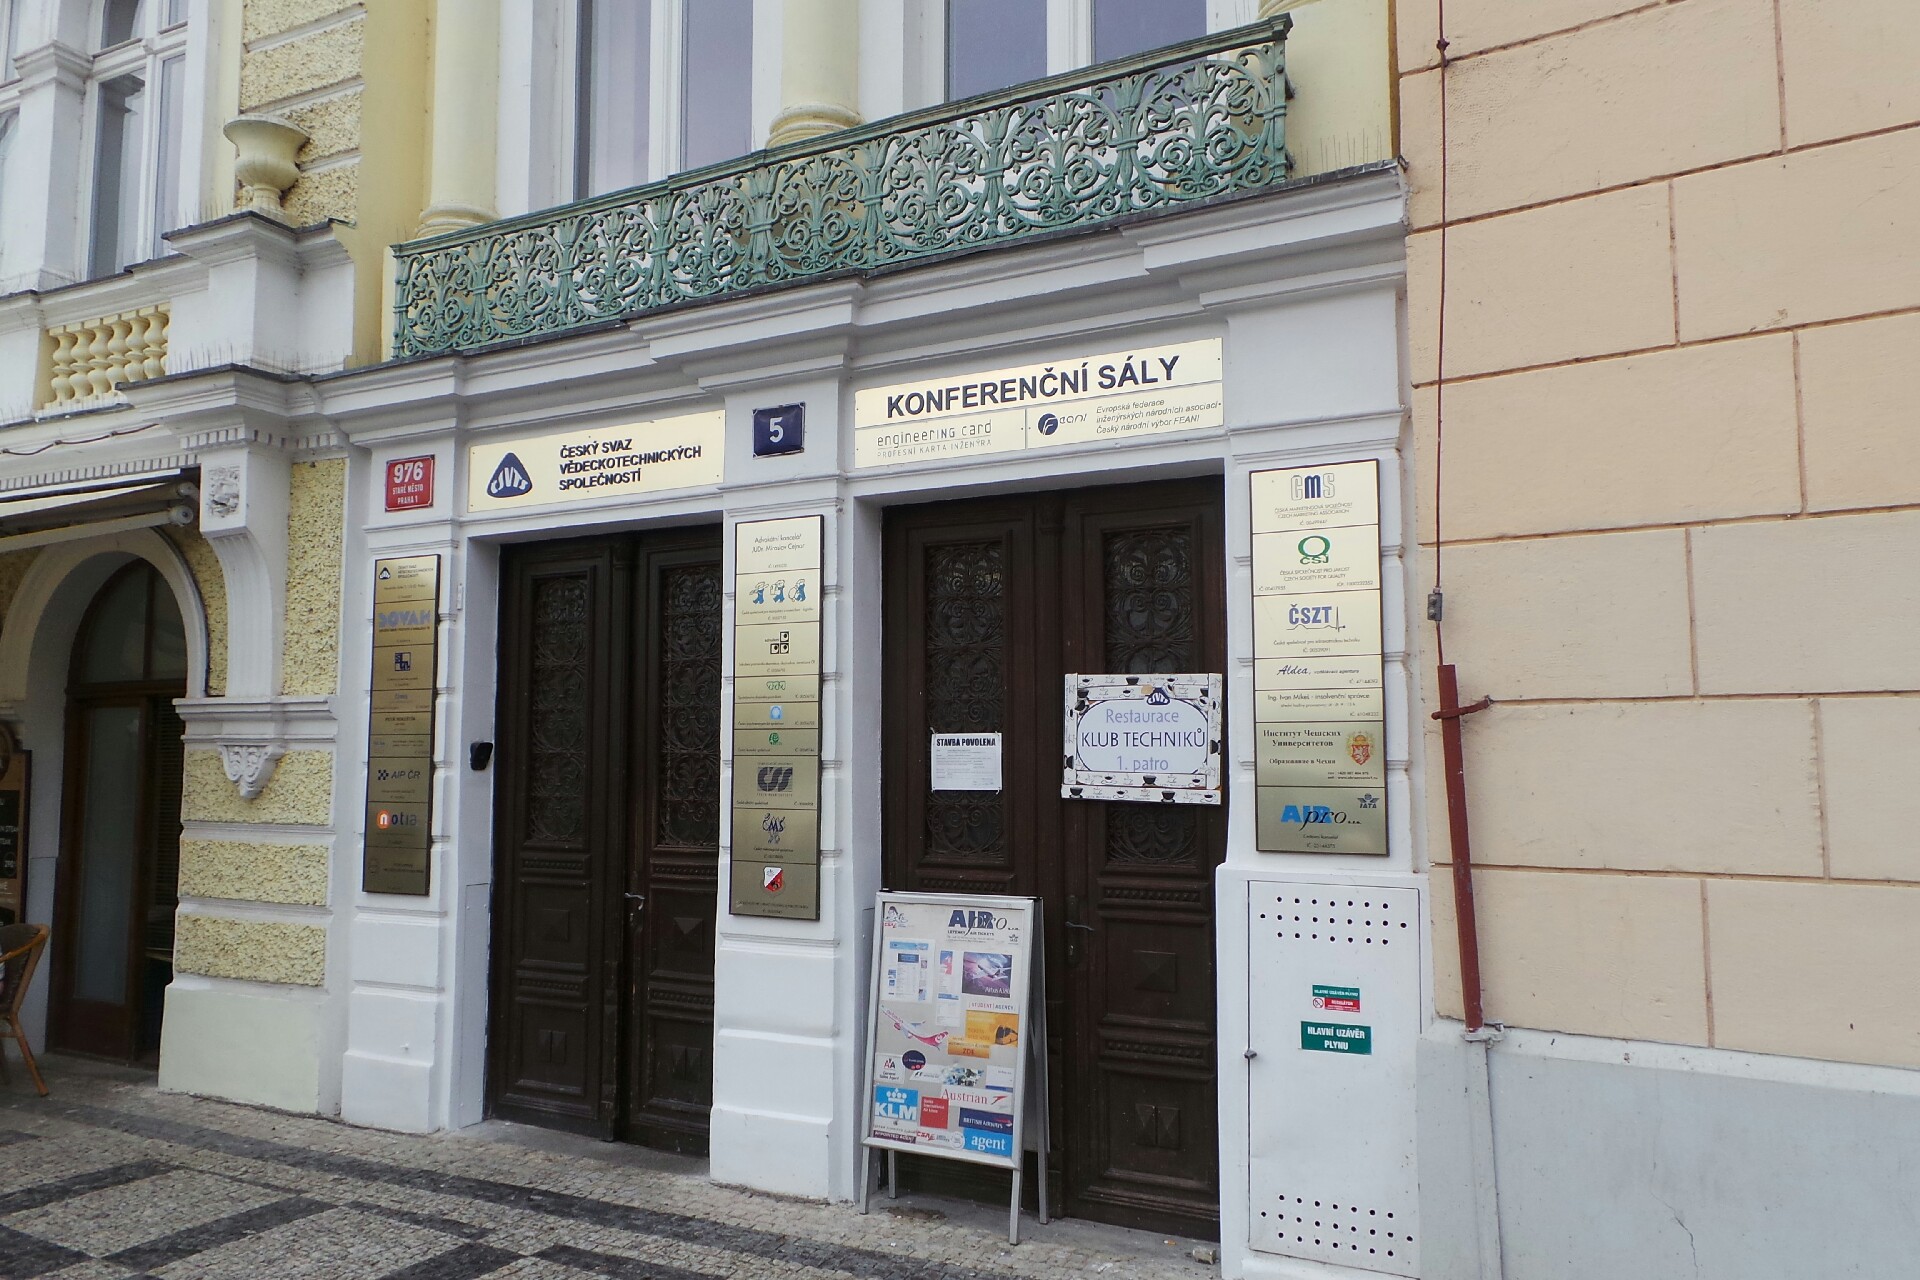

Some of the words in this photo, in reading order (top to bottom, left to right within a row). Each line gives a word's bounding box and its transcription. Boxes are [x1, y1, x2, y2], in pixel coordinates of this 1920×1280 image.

[887, 362, 1089, 419] KONFERENČNÍ
[1097, 355, 1180, 389] SÁLY
[1096, 403, 1131, 415] Evropská
[1131, 399, 1165, 410] federace
[1096, 410, 1145, 424] inženýrských
[1145, 406, 1184, 417] národních
[769, 416, 784, 443] 5
[961, 419, 992, 436] card
[1096, 425, 1120, 435] Český
[1120, 422, 1150, 432] národní
[1150, 419, 1173, 430] výbor
[1173, 415, 1200, 425] FEANI
[560, 441, 599, 459] ČESKÝ
[601, 438, 633, 454] SVAZ
[919, 444, 947, 454] KARTA
[950, 439, 992, 451] INŽENÝRA
[559, 445, 702, 475] VĚDECKOTECHNICKÝCH
[393, 461, 424, 484] 976
[559, 468, 642, 491] SPOLEČNOSTÍ
[392, 484, 407, 495] STARÉ
[407, 482, 424, 493] MĚSTO
[397, 495, 414, 505] PRAHA
[414, 495, 419, 503] 1
[1288, 603, 1333, 625] ČSZT
[1314, 692, 1346, 700] insolvenční
[1347, 692, 1370, 701] správce
[1105, 708, 1179, 724] Restaurace
[936, 738, 961, 747] STAVBA
[961, 737, 996, 747] POVOLENA
[1081, 731, 1119, 748] KLUB
[1123, 727, 1206, 748] TECHNIKŮ
[1263, 729, 1302, 739] Институт
[1304, 729, 1342, 738] Чешских
[1272, 739, 1334, 748] Университетов
[1117, 755, 1128, 771] 1.
[1133, 756, 1169, 773] patro
[1269, 758, 1309, 766] Образование
[391, 770, 406, 780] AIP
[378, 811, 418, 828] notia
[948, 909, 994, 930] AIR
[1307, 1026, 1334, 1037] HLAVNÍ
[1336, 1027, 1366, 1040] UZÁVĚR
[1324, 1039, 1349, 1051] PLYNU
[941, 1088, 988, 1105] Austrian
[874, 1102, 917, 1121] KLM
[962, 1117, 983, 1126] BRITISH
[983, 1118, 1004, 1129] AIRWAYS
[971, 1134, 1006, 1152] agent
